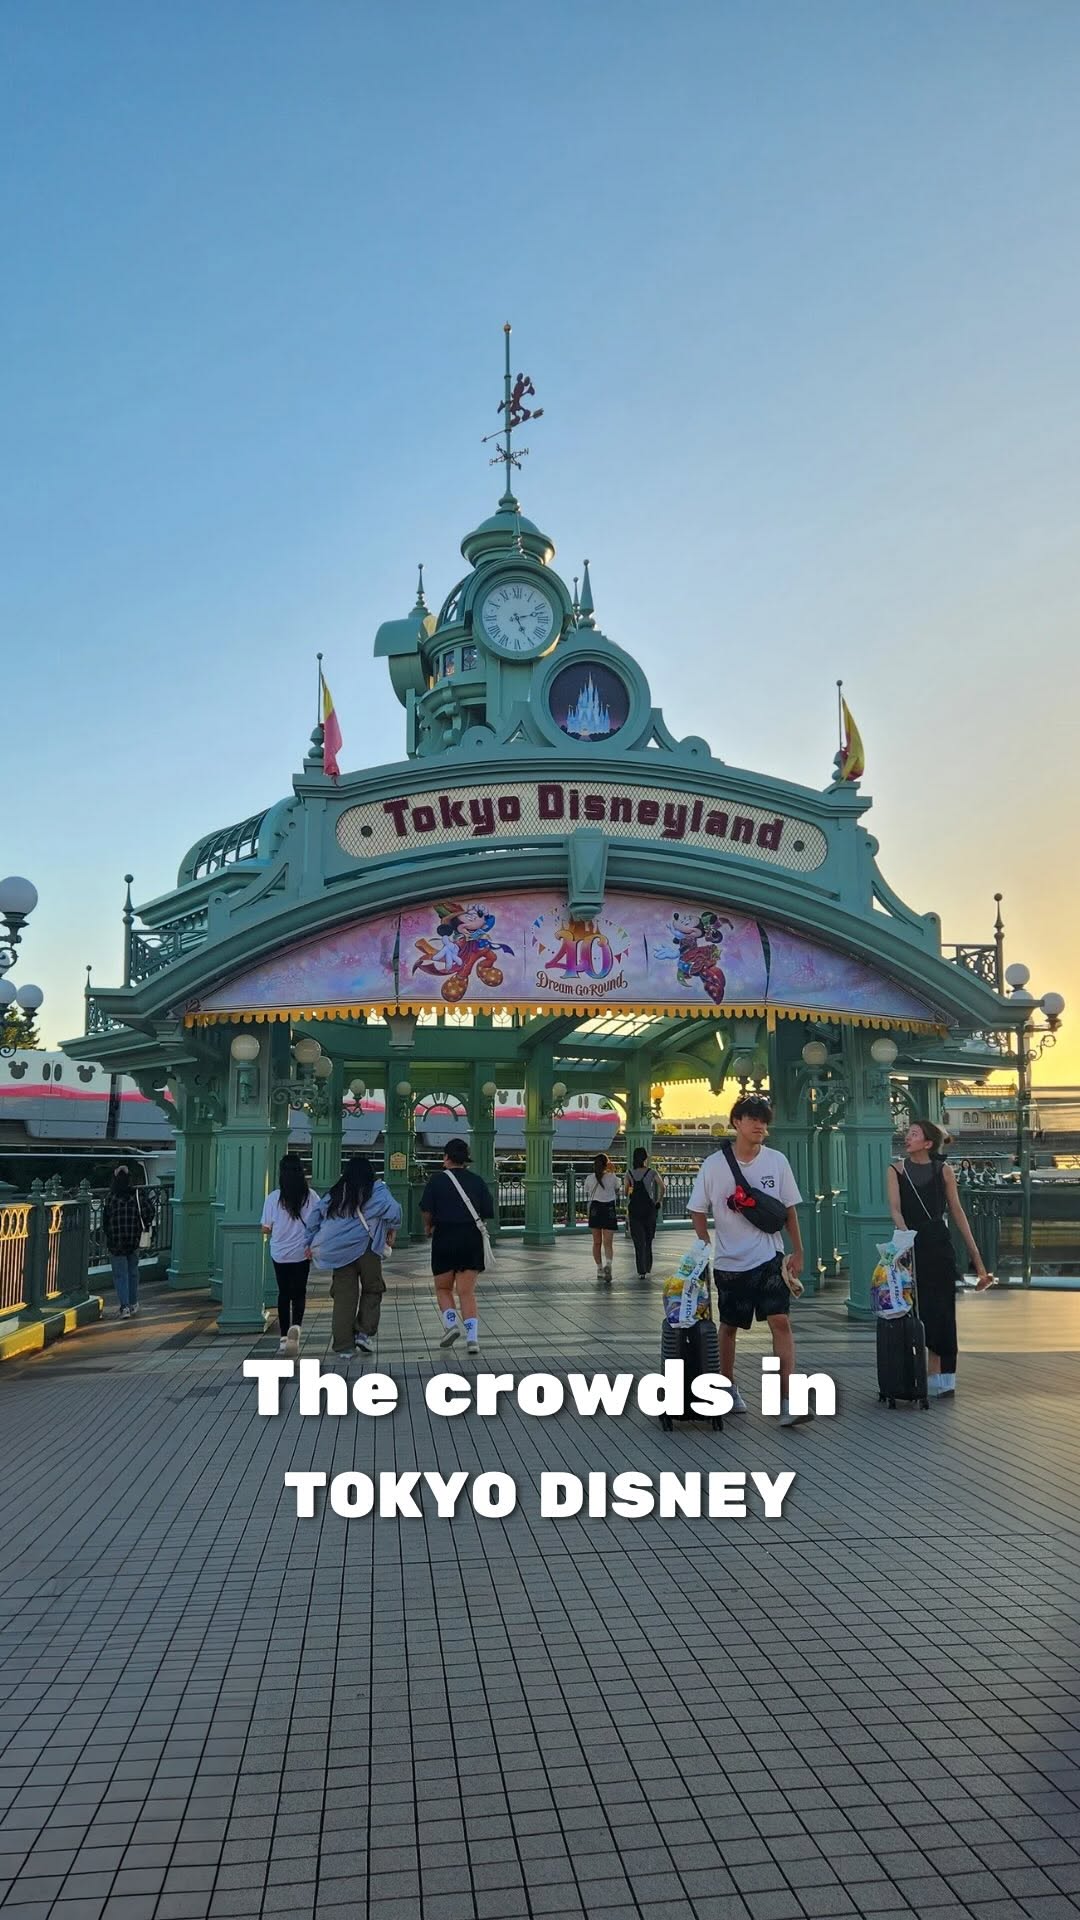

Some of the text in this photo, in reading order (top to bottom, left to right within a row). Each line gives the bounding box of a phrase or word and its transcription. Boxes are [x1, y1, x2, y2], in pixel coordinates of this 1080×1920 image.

[383, 784, 784, 851] Tokyo Disneyland
[545, 930, 613, 979] 40
